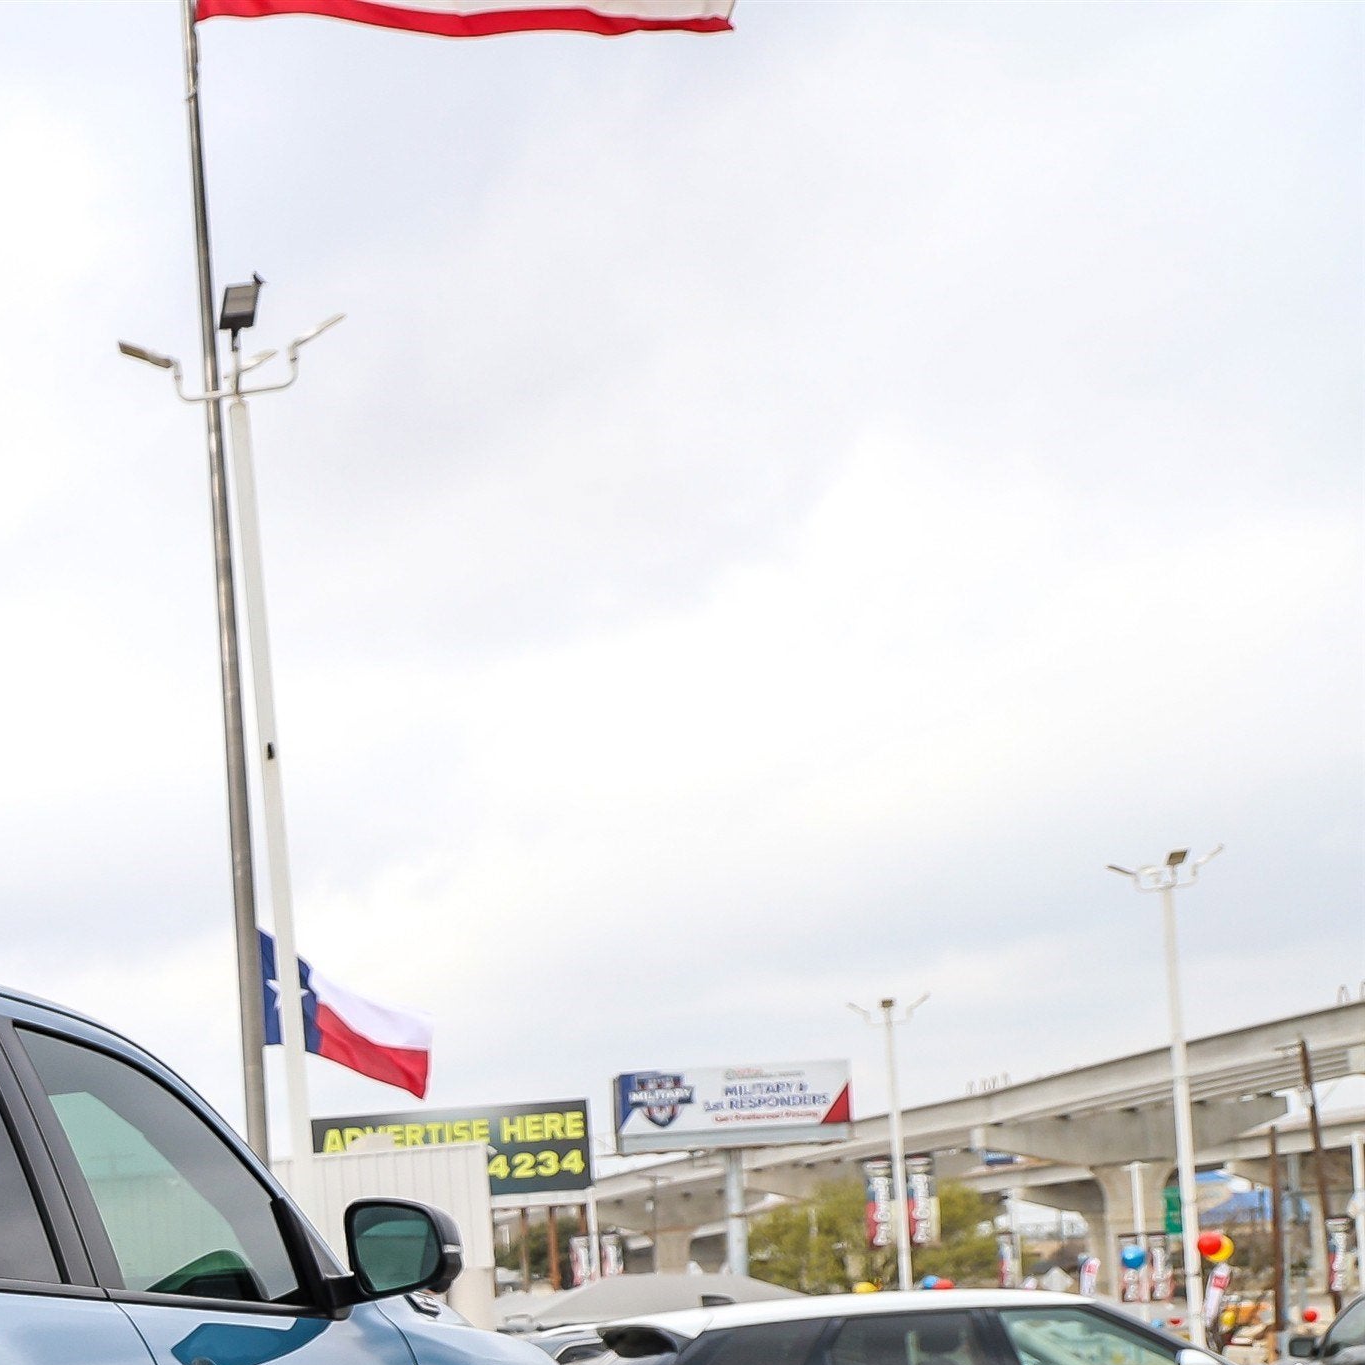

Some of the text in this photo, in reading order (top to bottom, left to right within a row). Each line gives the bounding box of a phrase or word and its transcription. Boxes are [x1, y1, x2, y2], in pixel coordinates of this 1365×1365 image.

[724, 1081, 794, 1097] MILITARY
[729, 1093, 831, 1110] RESPONDERS
[500, 1110, 585, 1144] HERE
[487, 1149, 585, 1179] 4234
